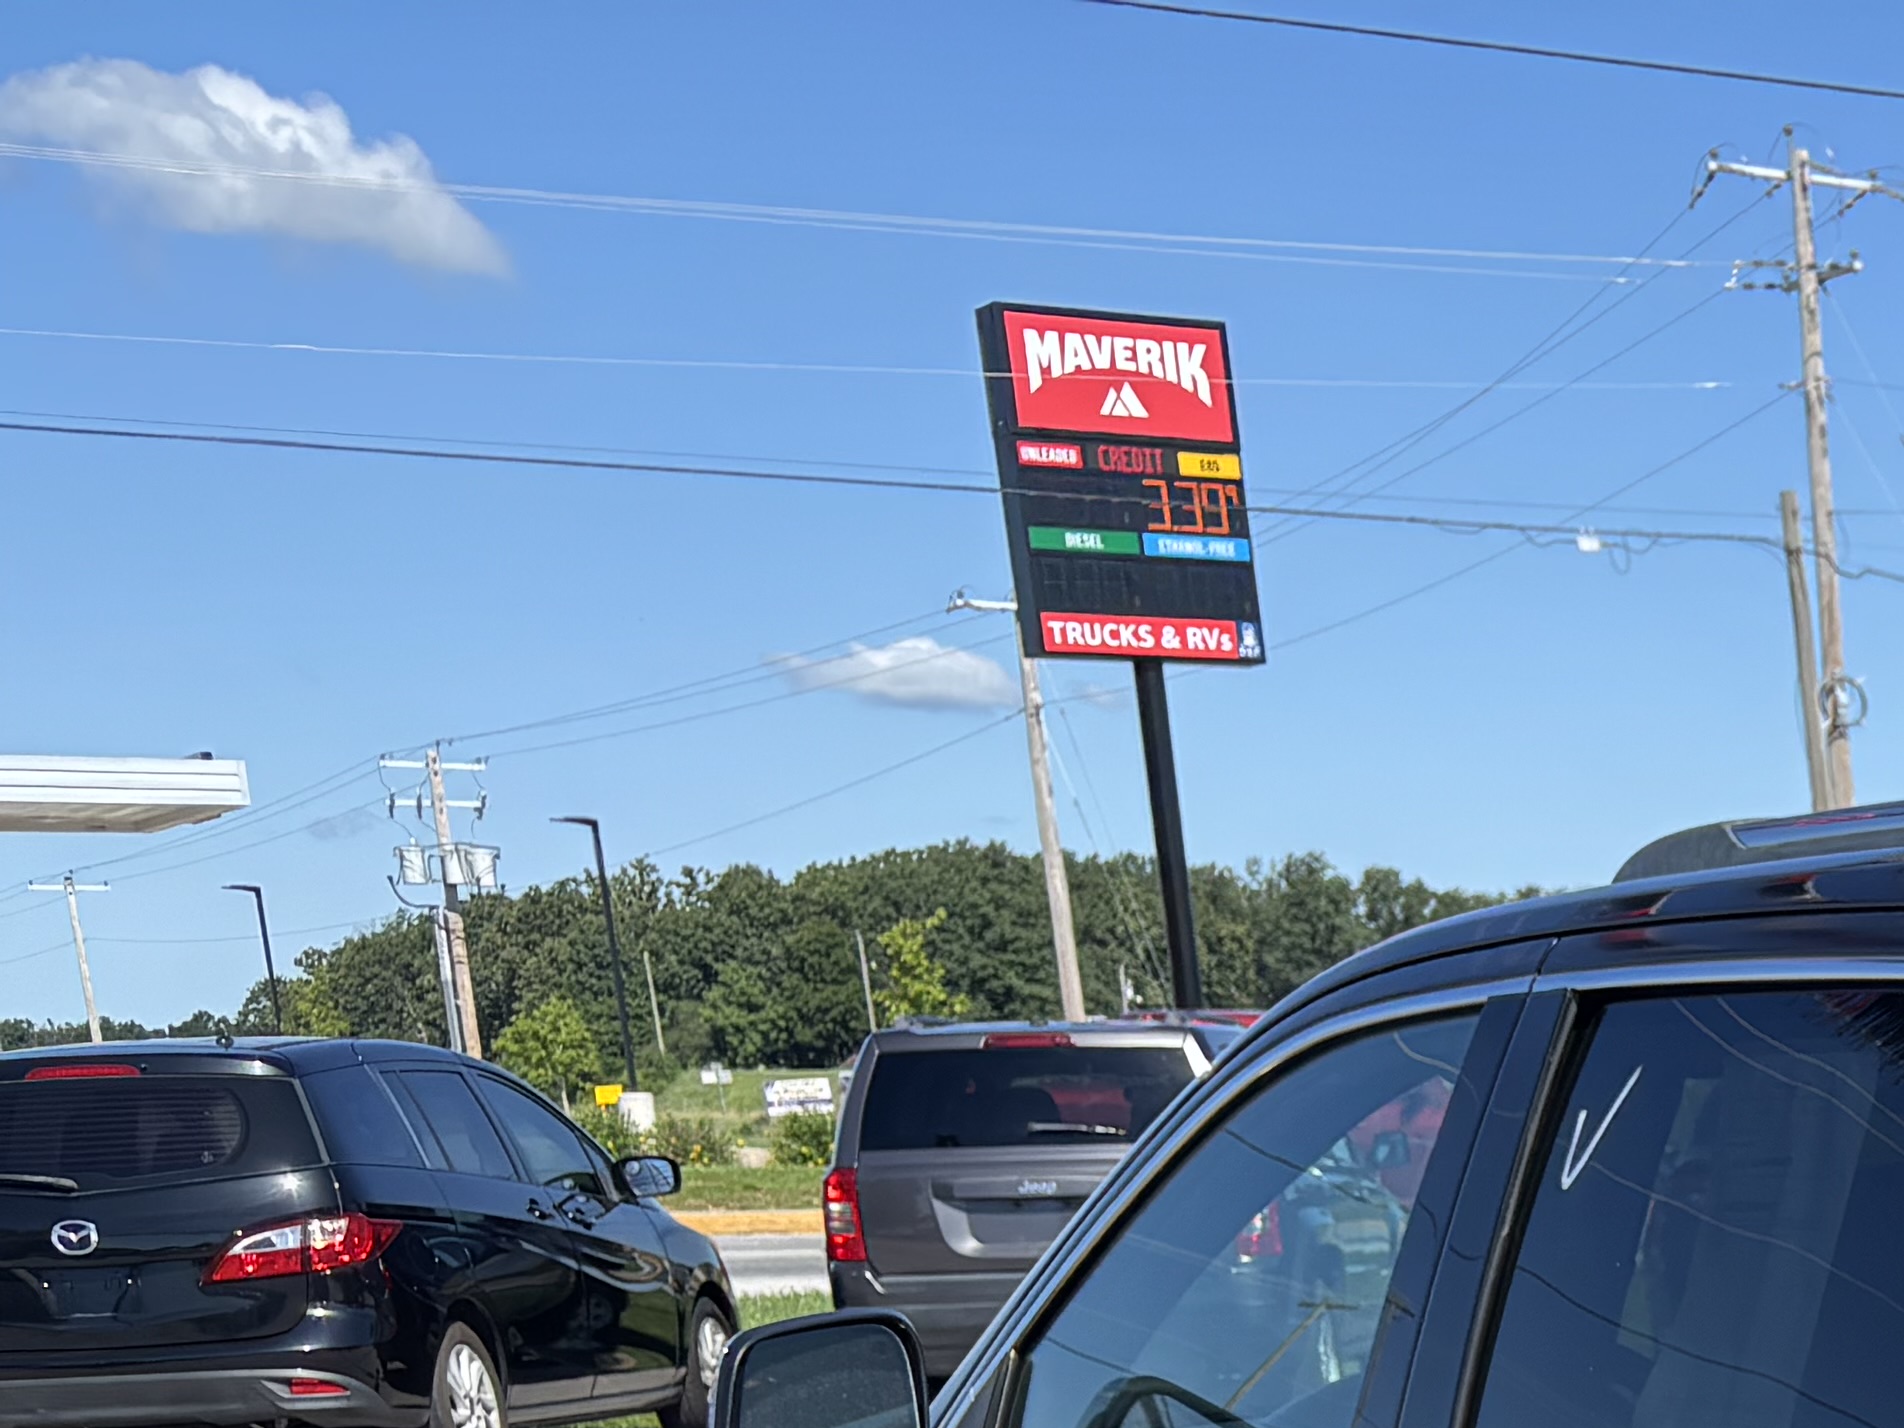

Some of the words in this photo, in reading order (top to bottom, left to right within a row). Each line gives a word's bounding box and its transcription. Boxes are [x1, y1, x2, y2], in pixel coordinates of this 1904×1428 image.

[1022, 327, 1213, 408] MAVERIK
[1097, 444, 1164, 475] CREDIT
[1064, 531, 1105, 549] DIESEL
[1046, 620, 1156, 649] TRUCKS
[1160, 624, 1182, 650] &
[1186, 626, 1233, 652] RVs
